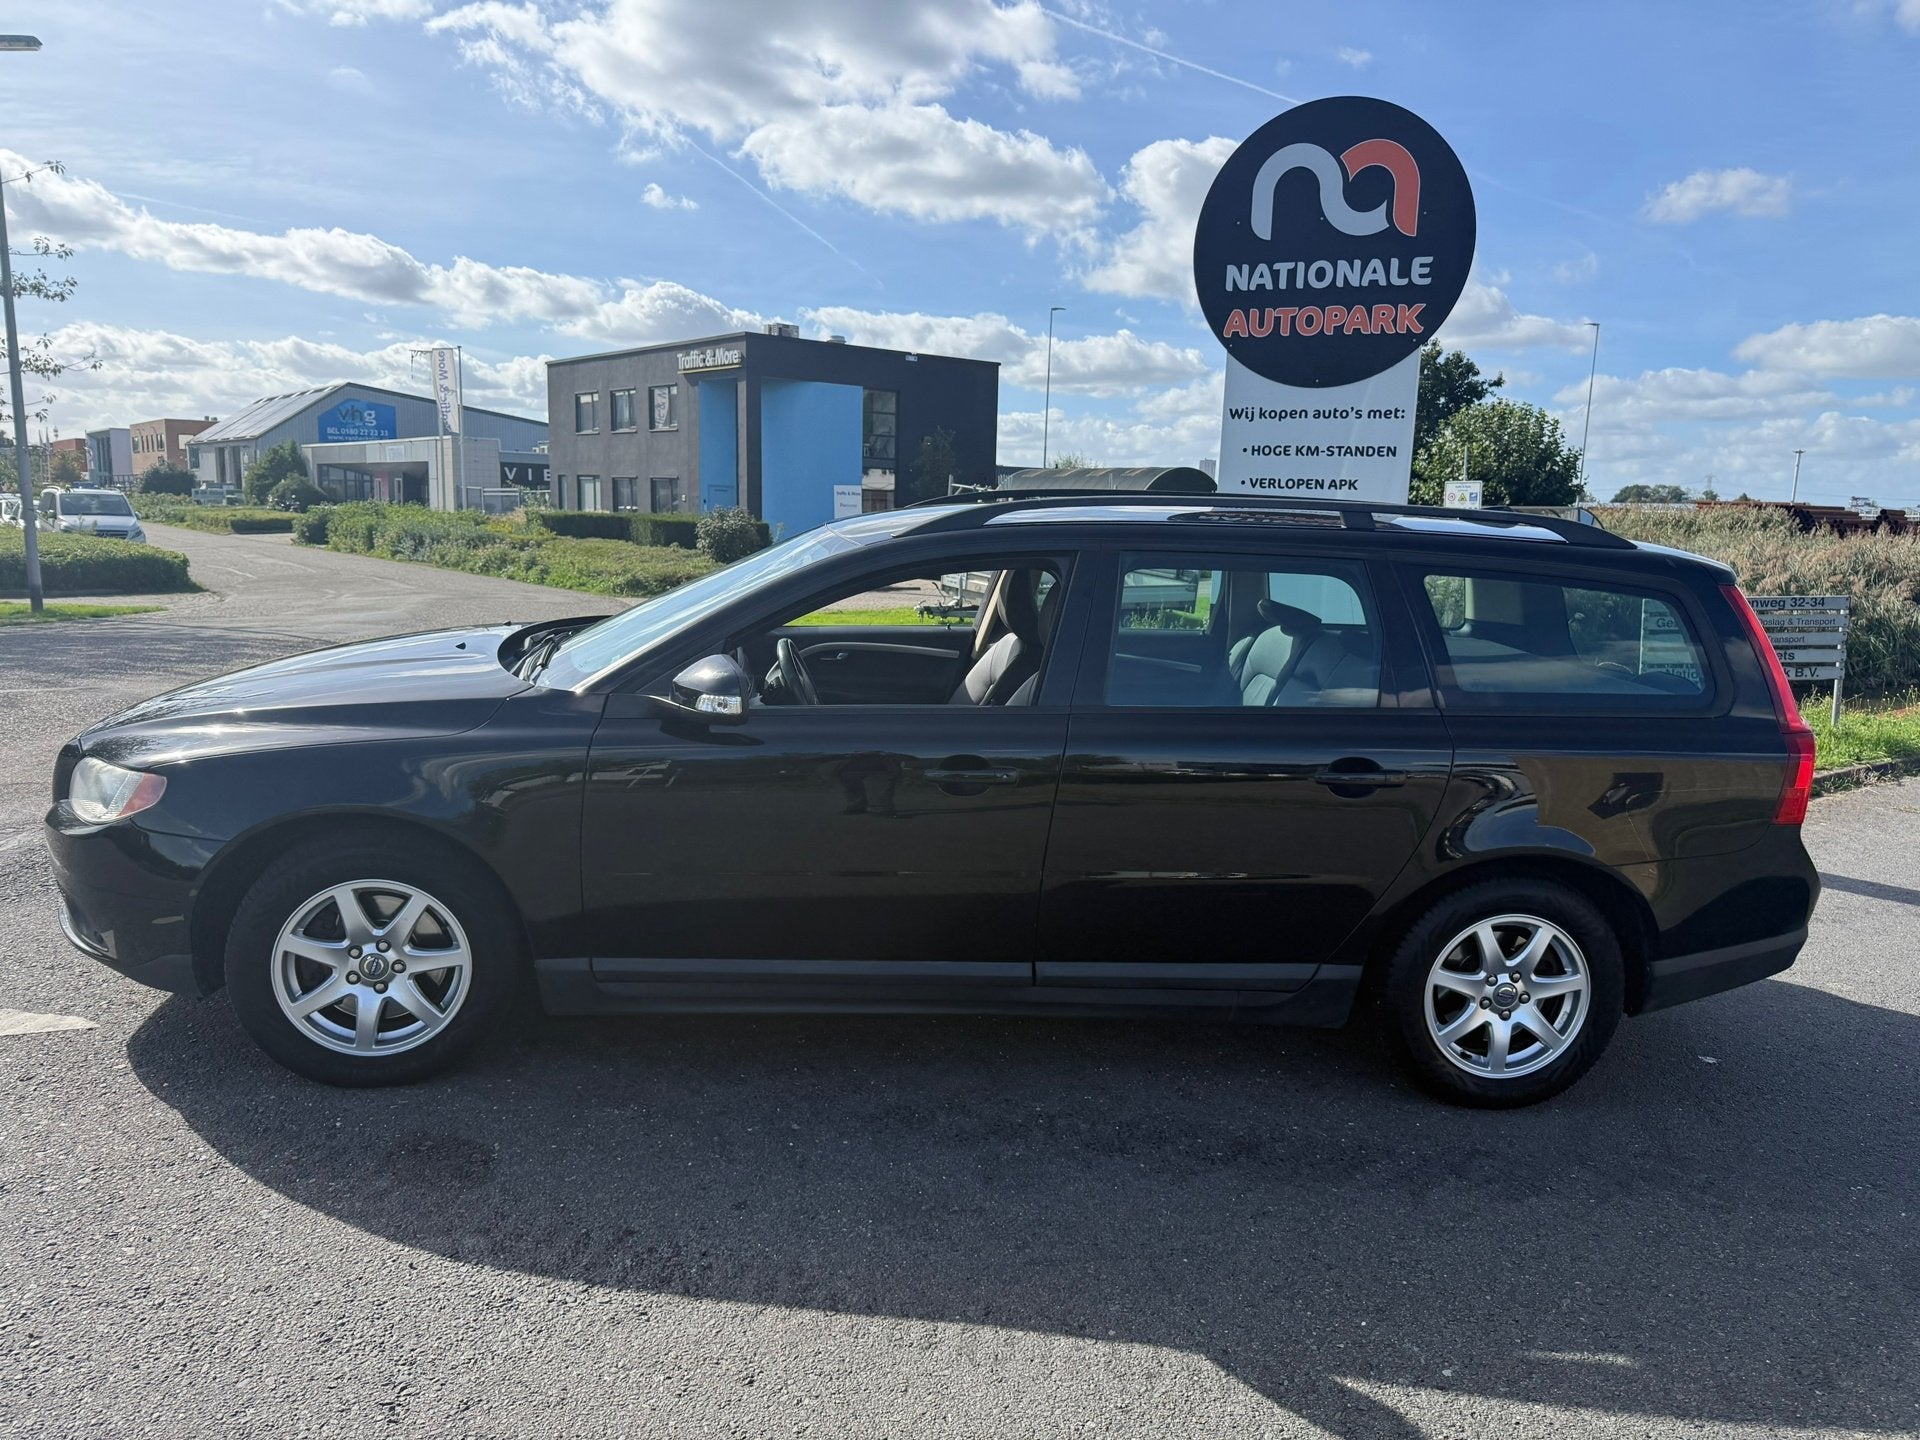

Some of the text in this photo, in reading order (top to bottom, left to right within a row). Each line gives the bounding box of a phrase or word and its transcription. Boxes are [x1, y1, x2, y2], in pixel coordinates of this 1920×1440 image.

[1225, 256, 1434, 292] NATIONALE
[1223, 303, 1427, 338] AUTOPARK
[677, 347, 740, 370] Traffic & More
[1229, 406, 1405, 422] Wij kopen auto's met:
[1251, 445, 1397, 458] HOGE KM-STANDEN
[1249, 478, 1359, 490] VERLOPEN APK
[1748, 597, 1825, 610] nweg 32-34
[1656, 618, 1674, 629] Ge
[1797, 618, 1836, 627] Transport
[1776, 650, 1795, 660] ets
[1795, 666, 1819, 678] B.V.
